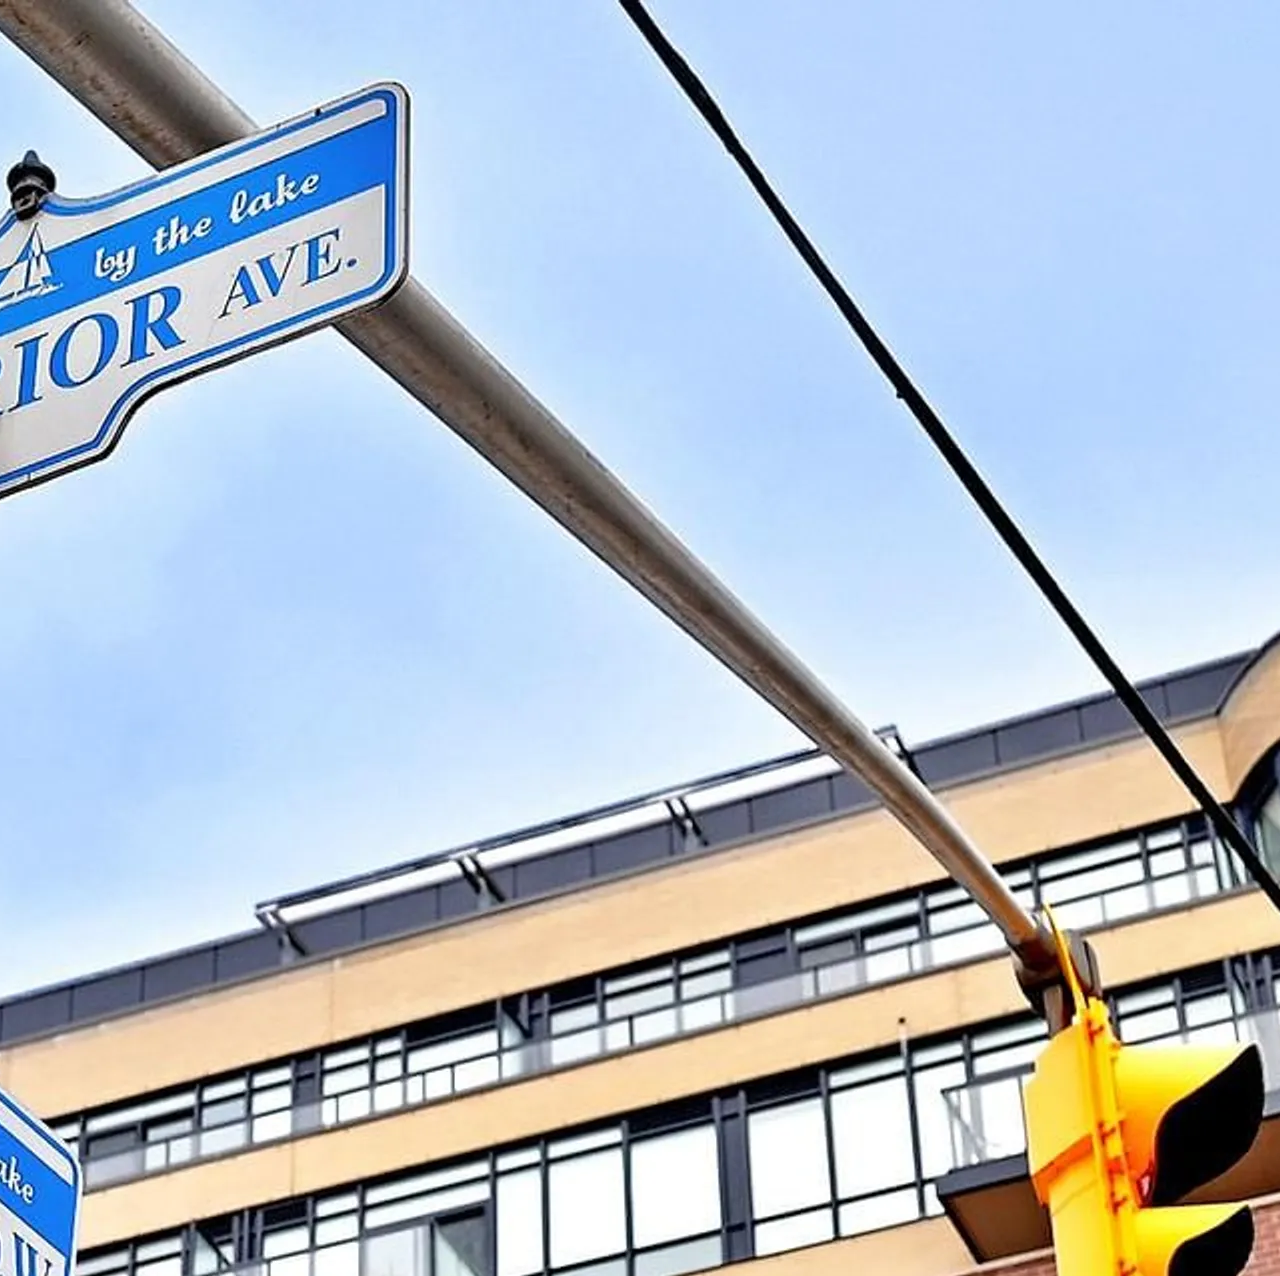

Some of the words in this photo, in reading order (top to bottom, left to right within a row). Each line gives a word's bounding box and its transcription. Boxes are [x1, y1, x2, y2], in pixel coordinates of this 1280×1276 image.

[94, 246, 137, 284] by
[152, 213, 213, 256] the
[228, 170, 321, 226] lake
[218, 227, 360, 318] AVE.
